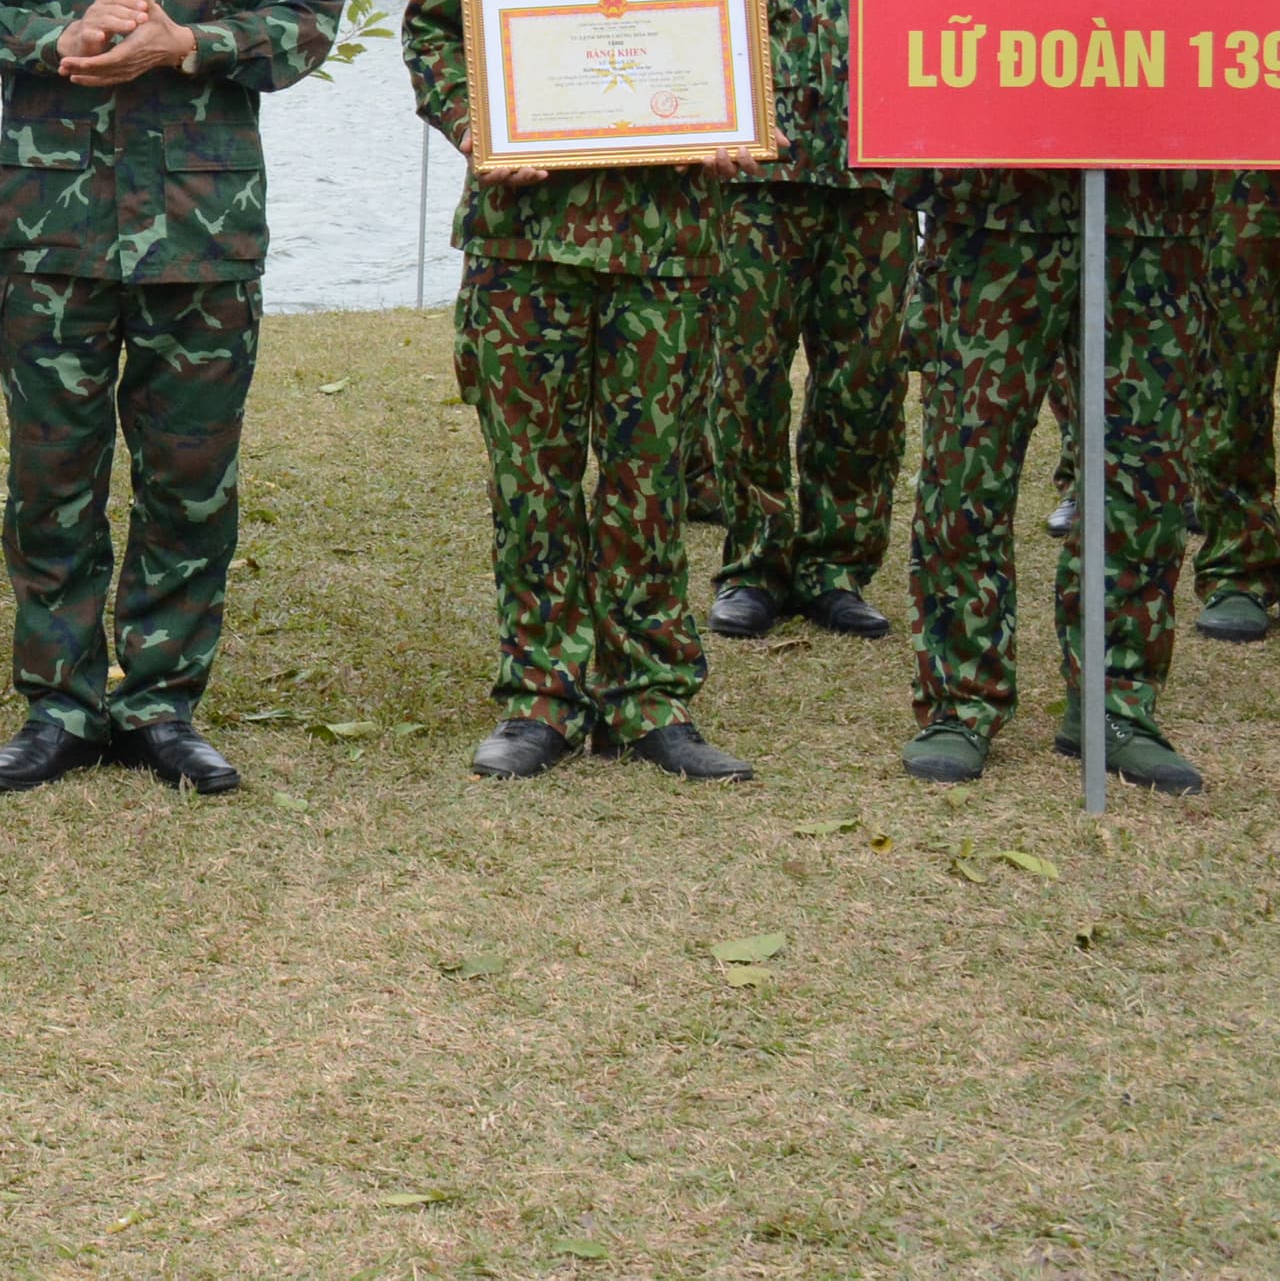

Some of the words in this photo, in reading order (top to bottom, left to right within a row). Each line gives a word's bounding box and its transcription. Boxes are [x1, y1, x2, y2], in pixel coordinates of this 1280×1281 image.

[618, 47, 648, 58] KHEN
[907, 14, 987, 88] LỮ
[997, 17, 1165, 88] ĐOÀN
